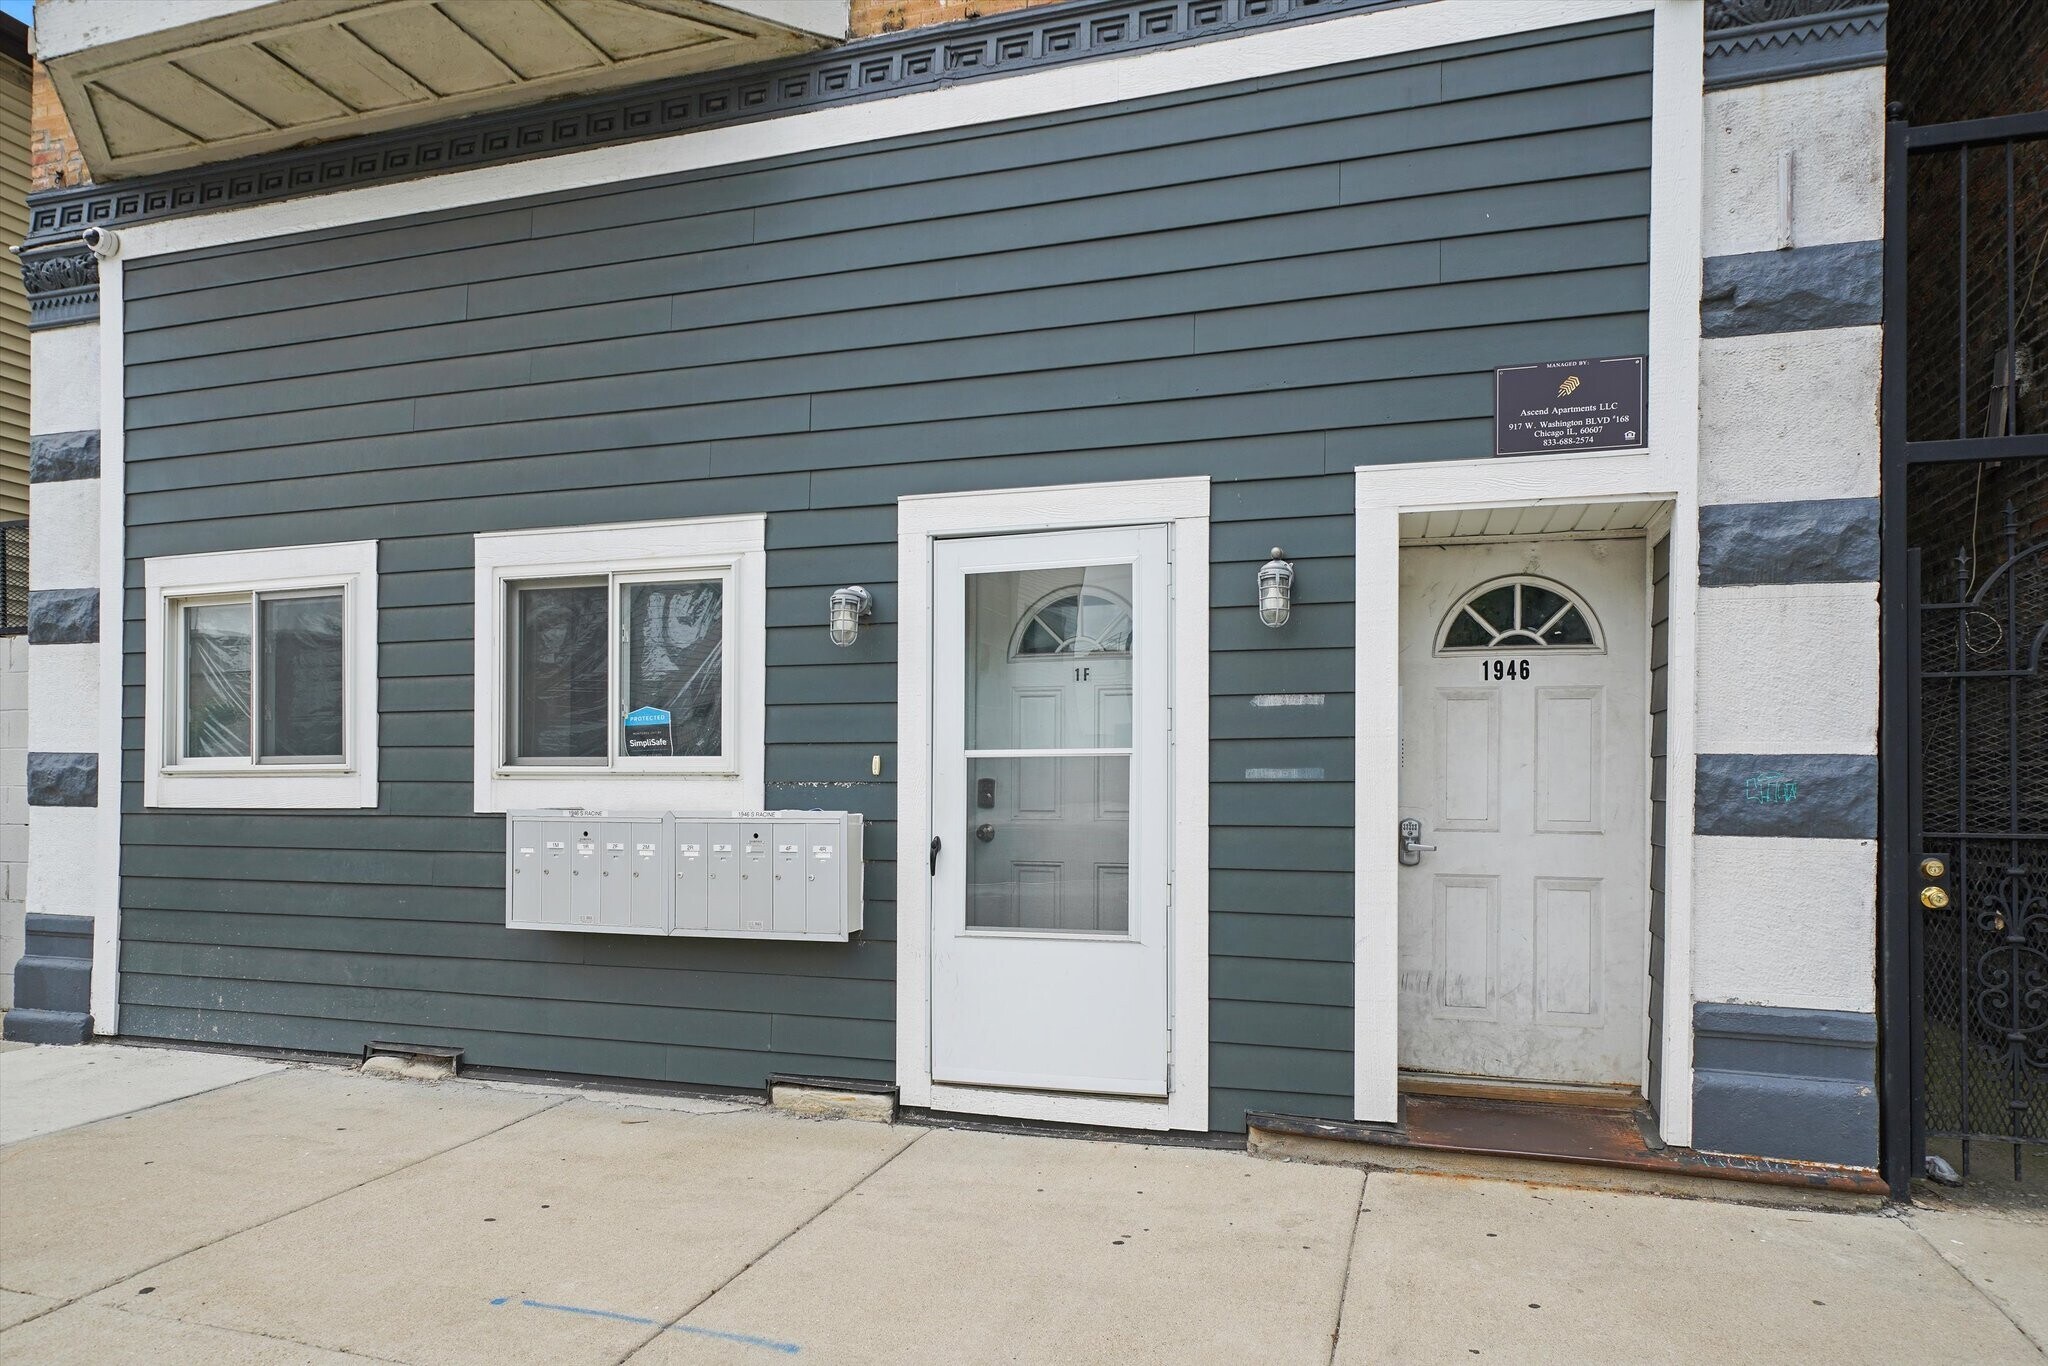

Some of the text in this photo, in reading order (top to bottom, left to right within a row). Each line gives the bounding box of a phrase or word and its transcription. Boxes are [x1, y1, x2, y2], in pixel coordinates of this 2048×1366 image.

[1546, 361, 1577, 369] MANAGED
[1520, 402, 1618, 417] Ascend Apartments LLC
[1508, 423, 1523, 431] 917
[1524, 422, 1537, 430] W.
[1540, 419, 1583, 429] Washington
[1585, 416, 1611, 425] BLVD
[1534, 429, 1564, 438] Chicago
[1580, 426, 1603, 435] 60607
[1543, 436, 1594, 447] 833-688-2574
[1075, 667, 1090, 682] 1F
[1482, 659, 1530, 681] 1946
[630, 714, 666, 722] PROTECTED
[629, 738, 667, 748] SimpliSafe
